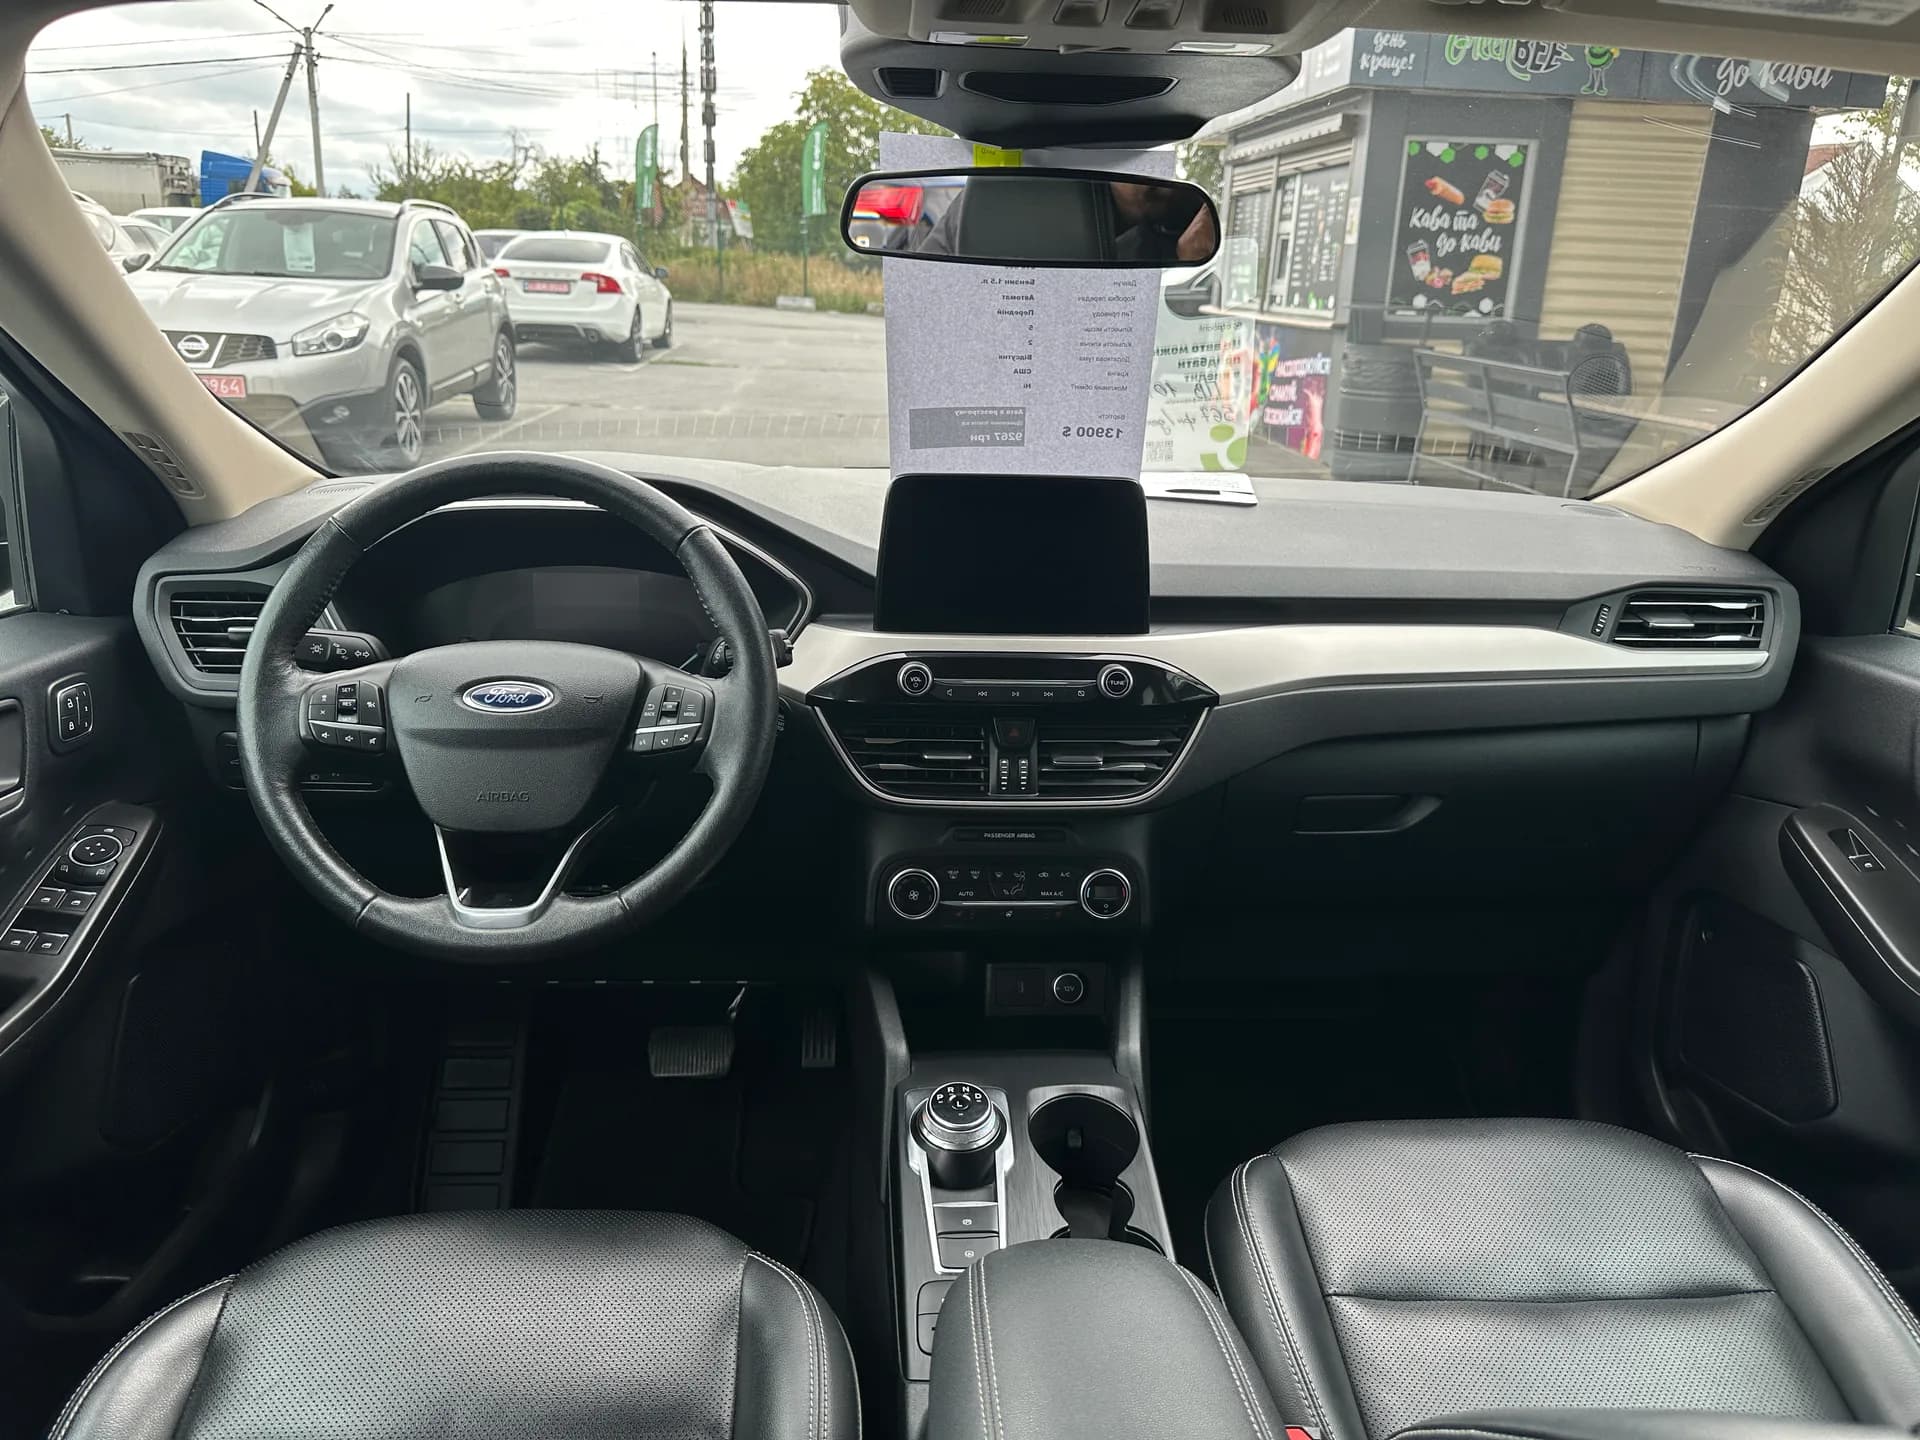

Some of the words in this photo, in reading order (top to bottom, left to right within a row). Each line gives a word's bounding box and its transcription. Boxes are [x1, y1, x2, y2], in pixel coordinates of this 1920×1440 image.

[1373, 31, 1407, 52] день
[1359, 53, 1416, 77] краще!
[1408, 205, 1451, 231] Кава
[1453, 210, 1479, 231] та
[1436, 232, 1457, 257] до
[1460, 227, 1502, 252] кави
[202, 378, 240, 395] 964
[1109, 679, 1125, 687] TUNE
[484, 686, 531, 704] Ford
[477, 790, 530, 803] AIRBAG
[936, 1093, 944, 1101] P
